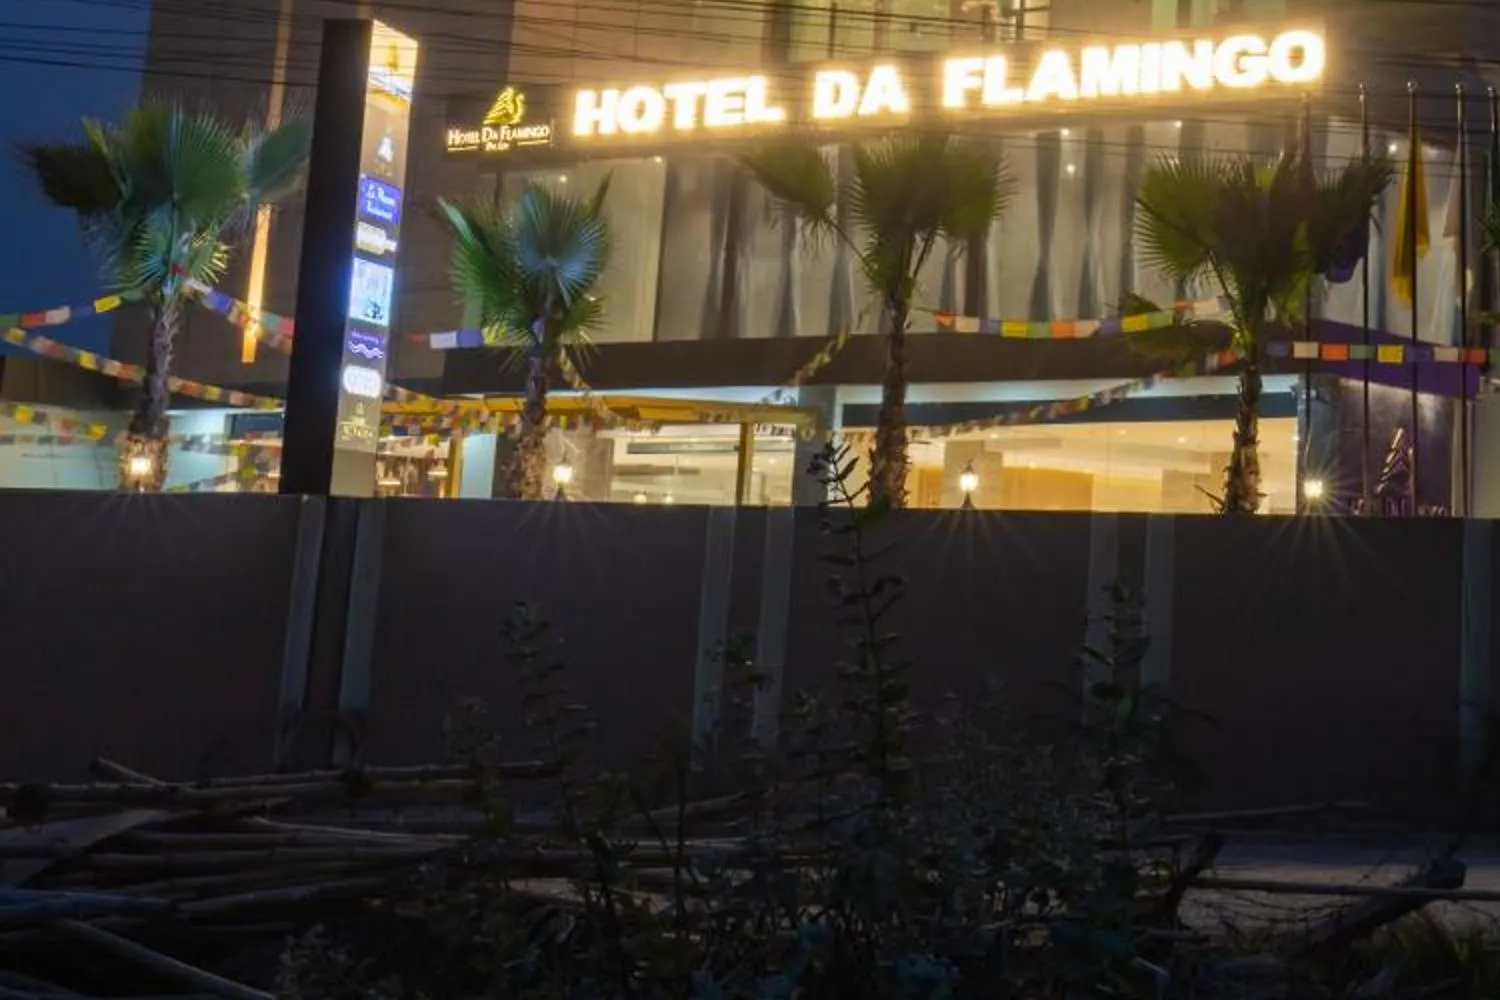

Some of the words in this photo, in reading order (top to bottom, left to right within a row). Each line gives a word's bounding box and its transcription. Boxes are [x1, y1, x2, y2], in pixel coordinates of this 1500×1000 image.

[571, 74, 786, 138] HOTEL
[810, 63, 911, 119] DA
[941, 28, 1326, 110] FLAMINGO
[447, 129, 480, 146] HOTEL
